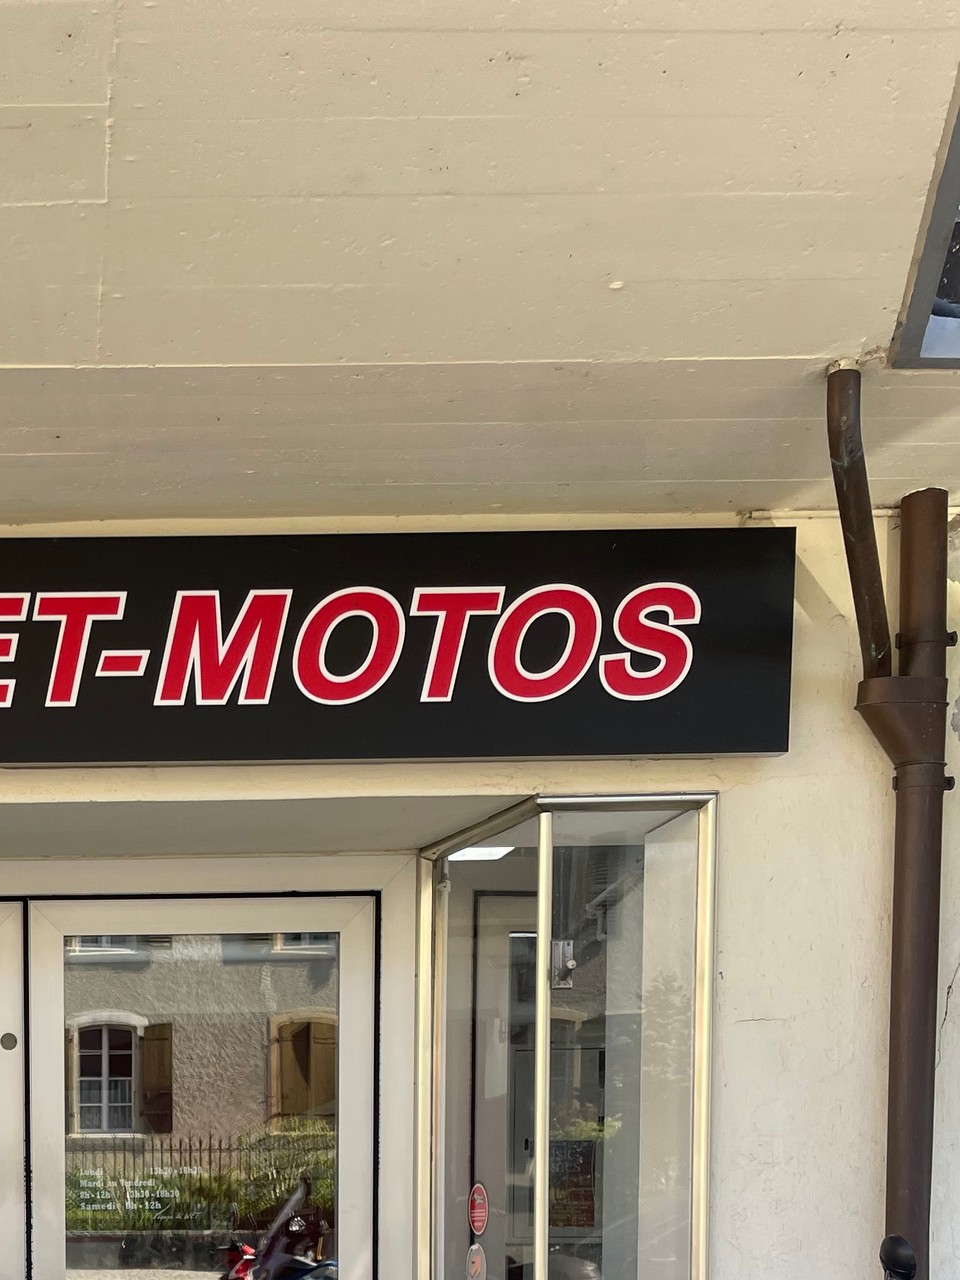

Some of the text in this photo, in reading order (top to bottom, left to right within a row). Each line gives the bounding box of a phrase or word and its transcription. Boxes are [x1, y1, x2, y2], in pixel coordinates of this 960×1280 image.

[80, 1168, 103, 1176] Lundi
[80, 1179, 104, 1188] Mardi
[119, 1178, 155, 1187] Vendredi
